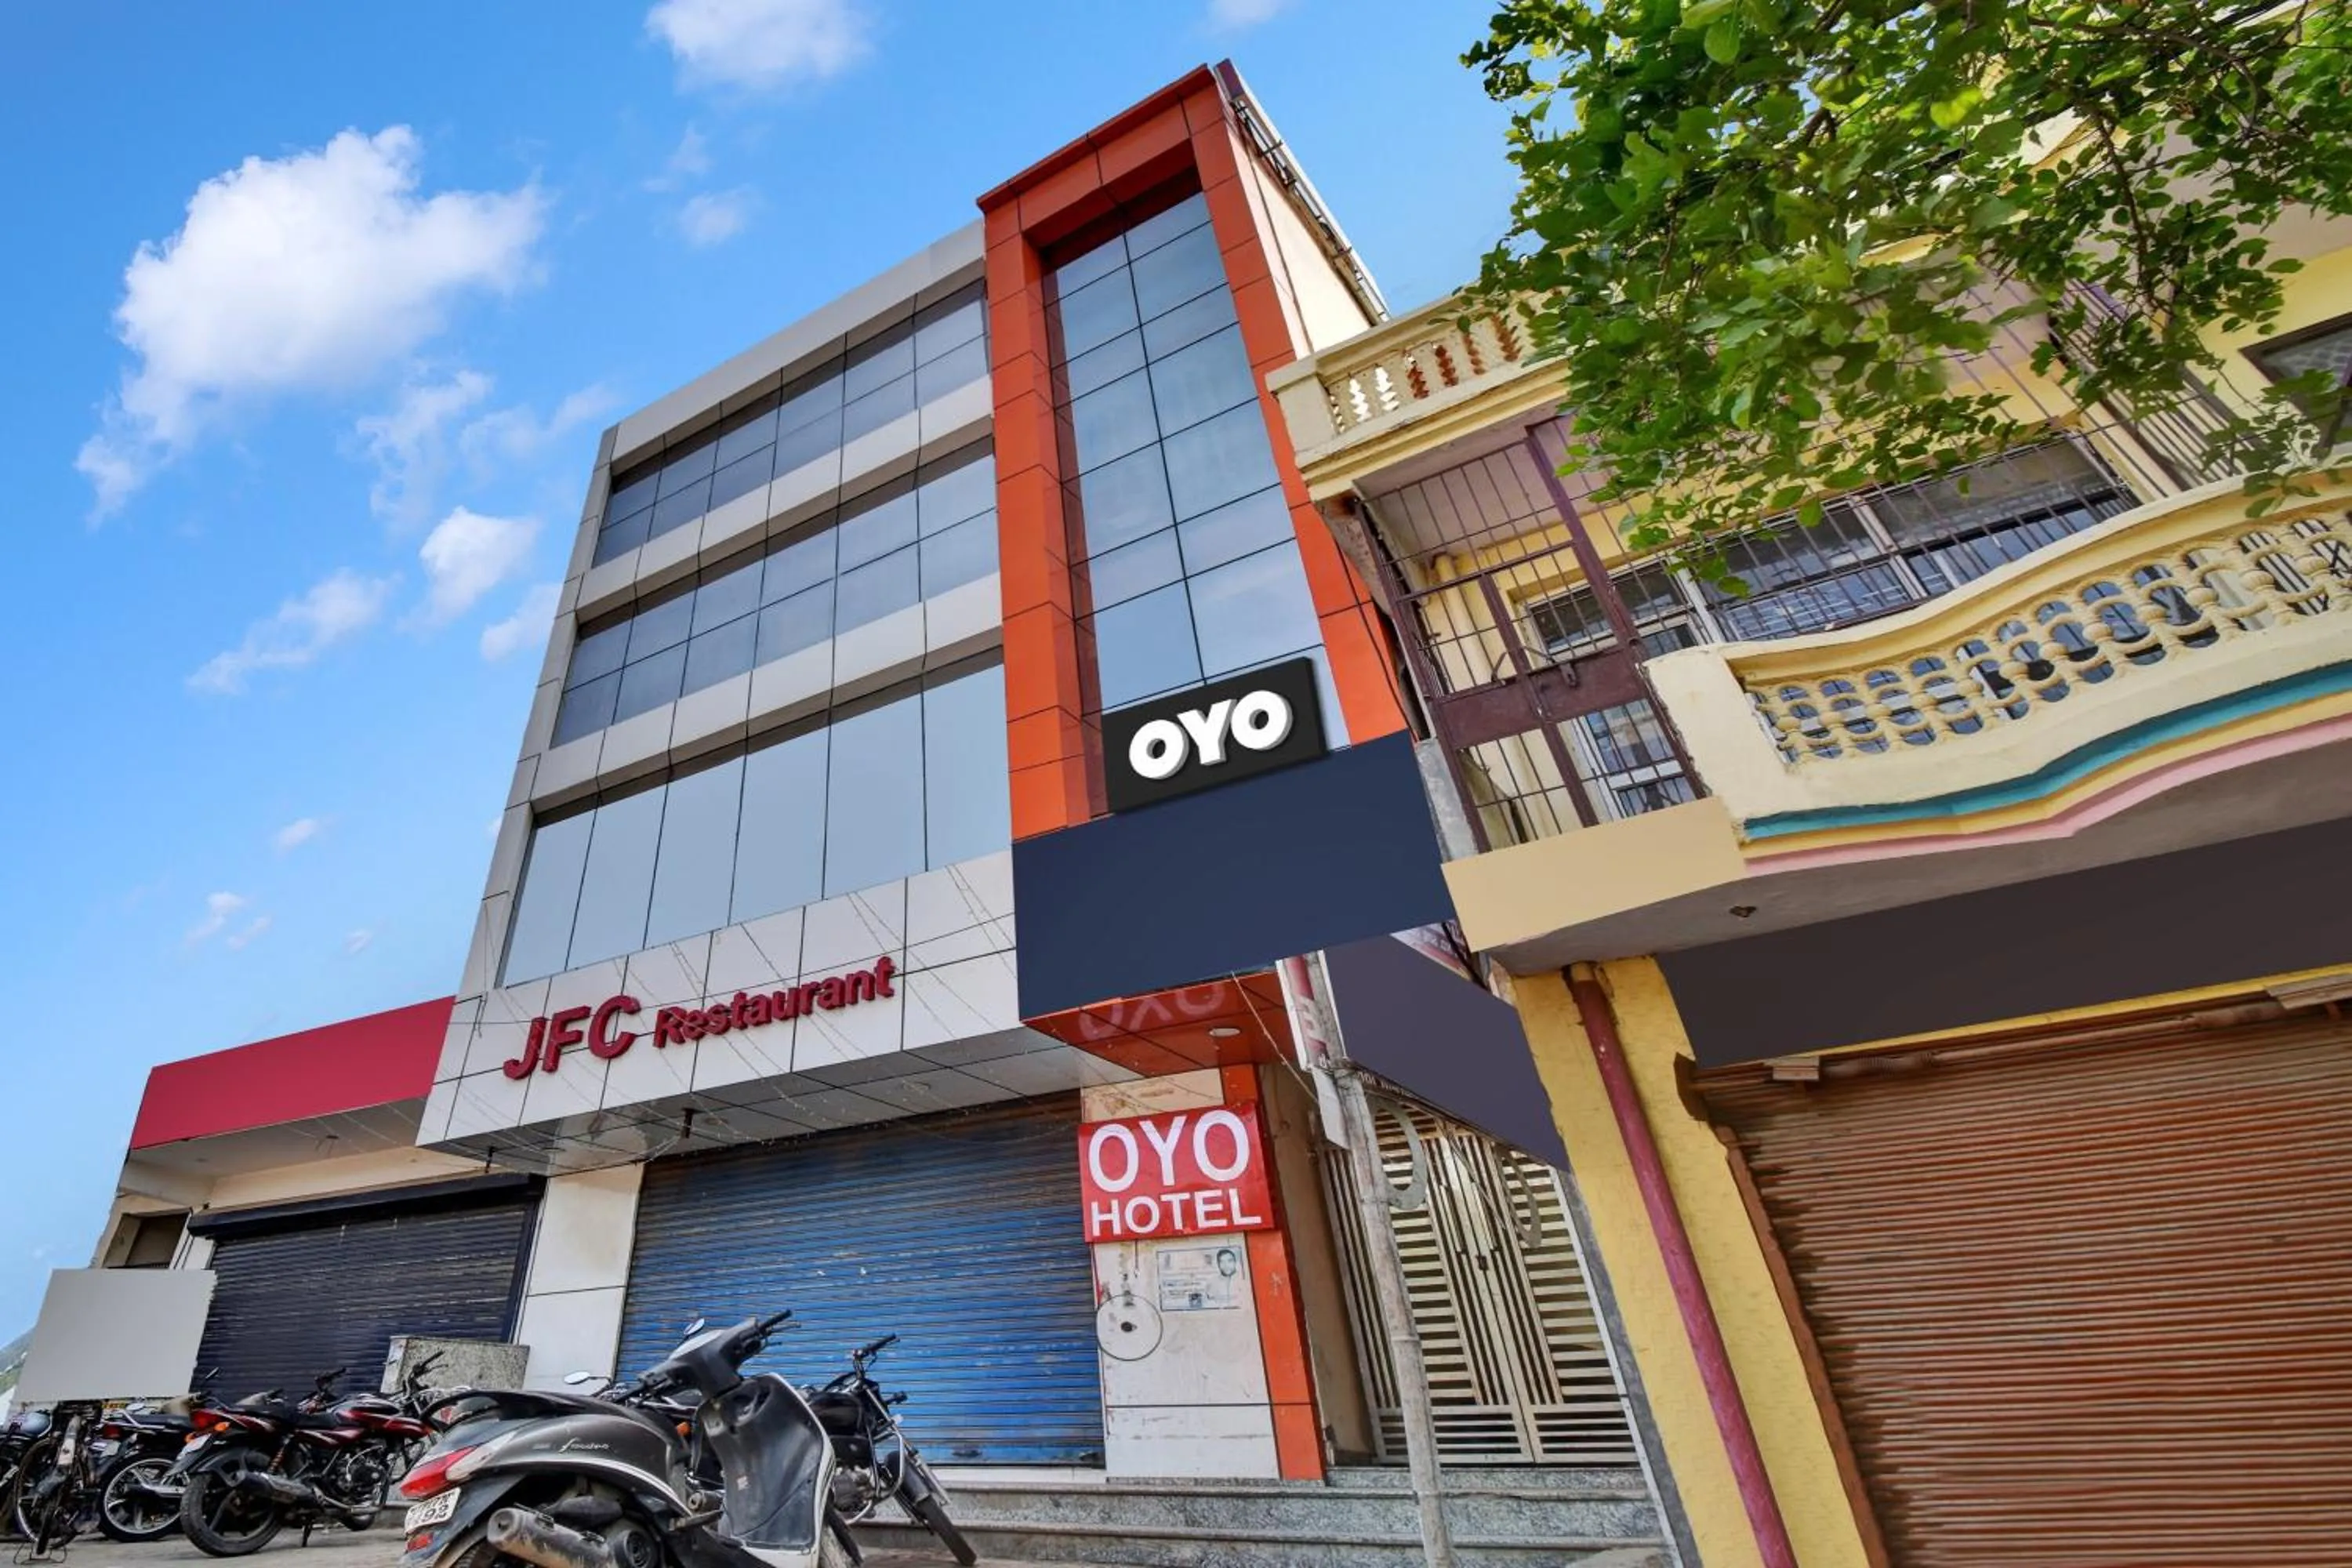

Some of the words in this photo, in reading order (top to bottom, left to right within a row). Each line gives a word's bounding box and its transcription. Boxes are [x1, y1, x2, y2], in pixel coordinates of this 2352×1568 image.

[1128, 690, 1293, 780] OYO
[503, 995, 641, 1080] JFC
[652, 956, 895, 1048] Restaurant
[1088, 1109, 1250, 1192] OYO
[1091, 1188, 1261, 1236] HOTEL
